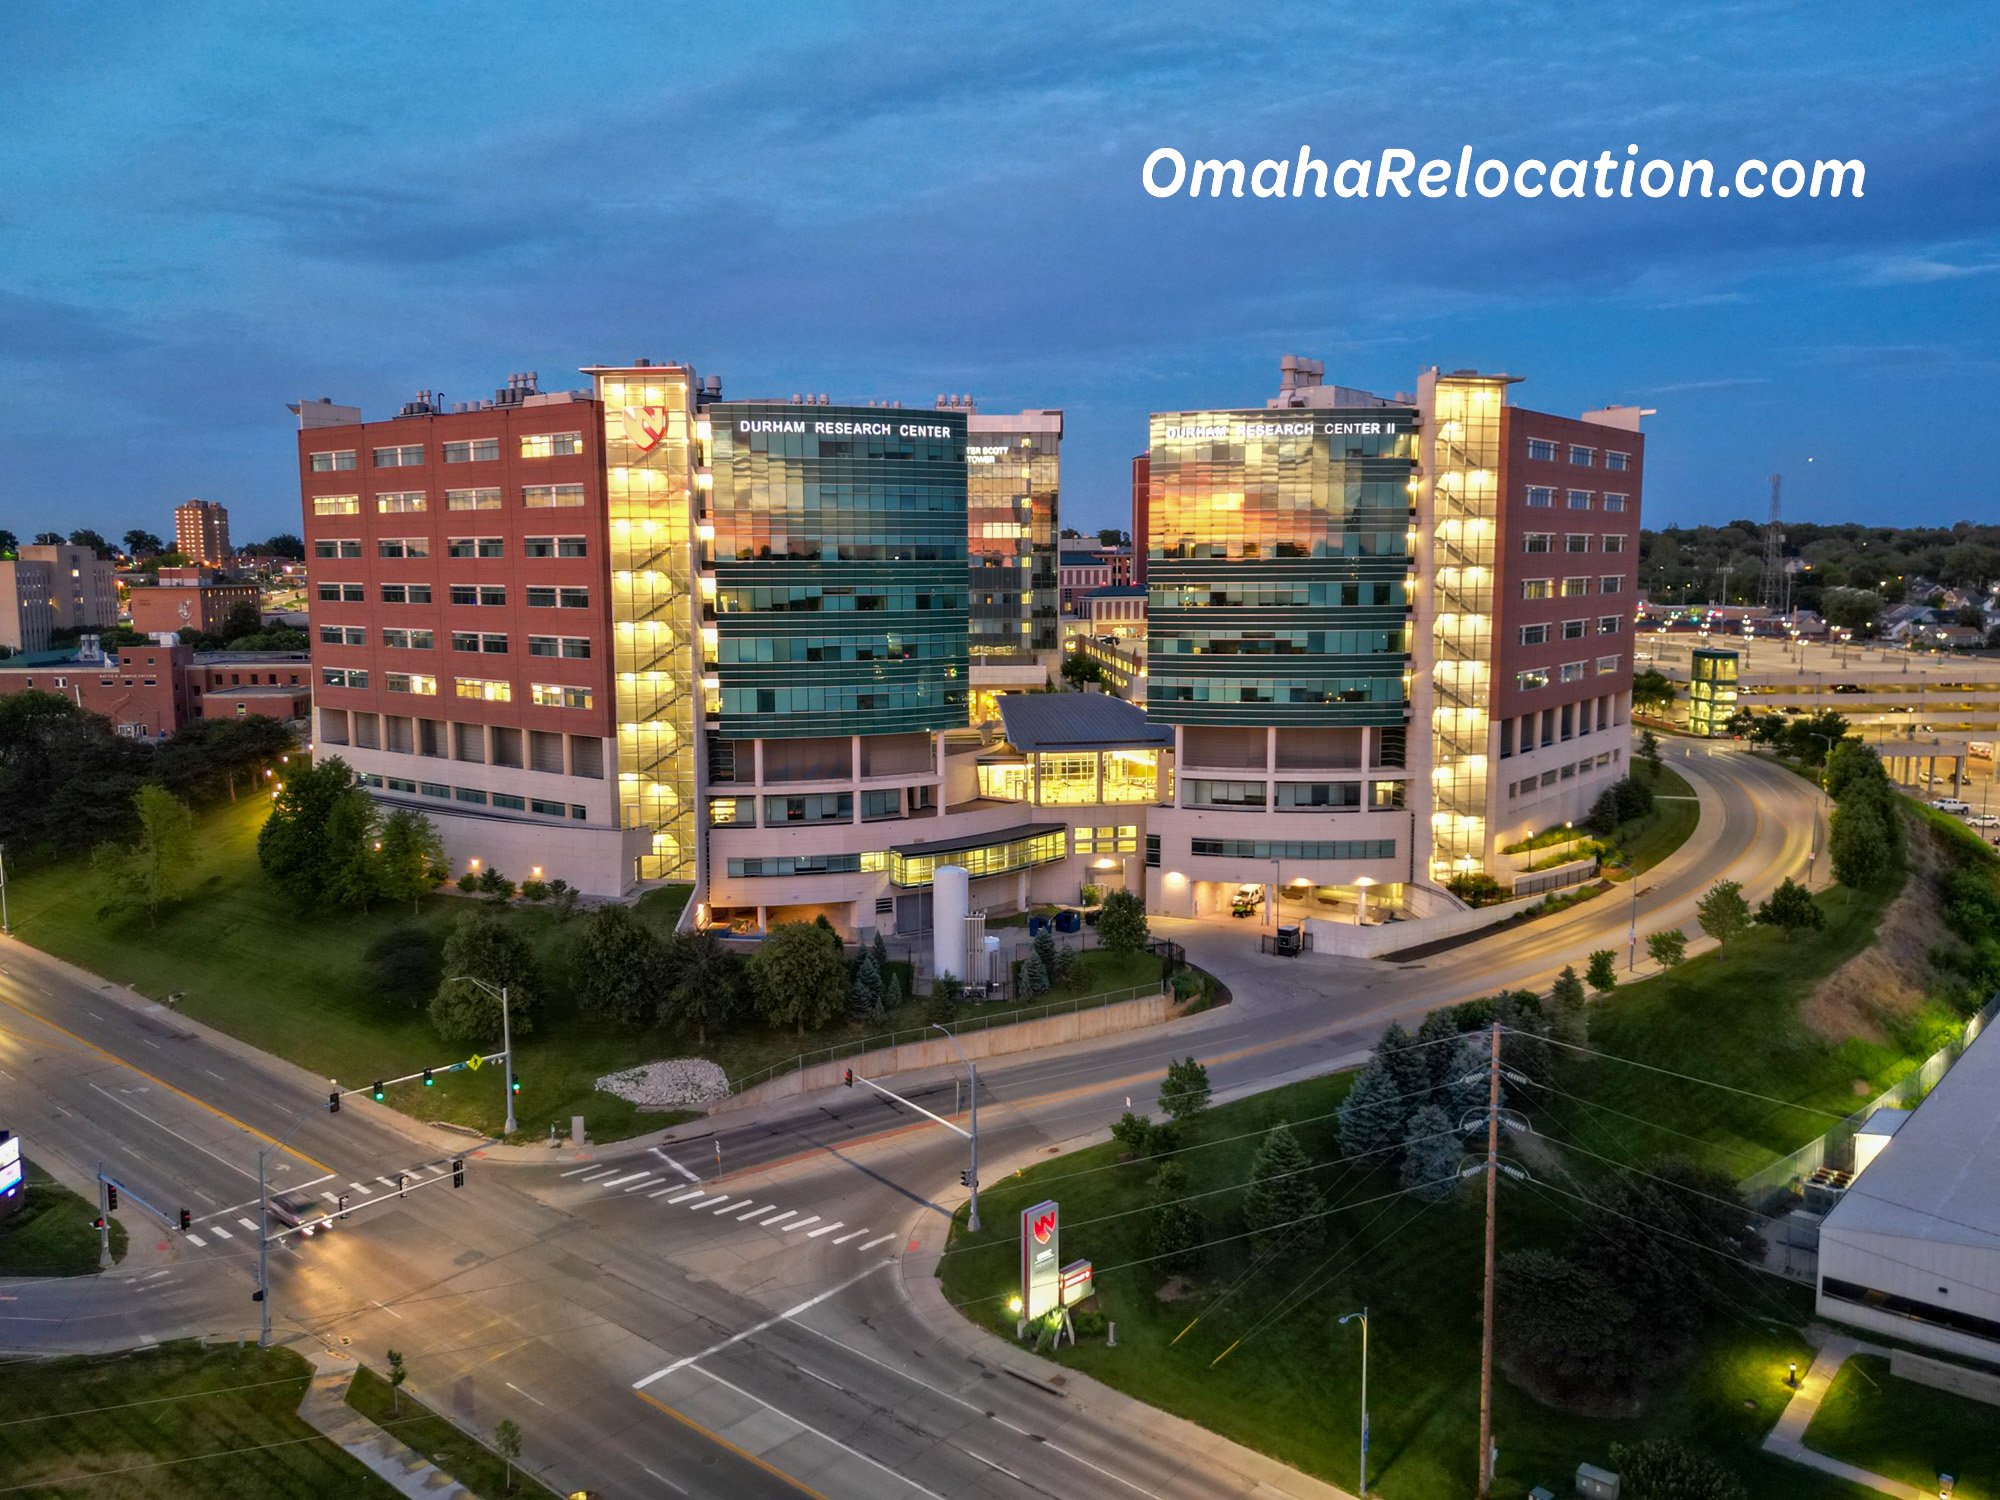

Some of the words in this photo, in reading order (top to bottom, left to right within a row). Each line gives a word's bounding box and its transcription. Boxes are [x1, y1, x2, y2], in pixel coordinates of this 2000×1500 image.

[740, 420, 805, 433] DURHAM
[815, 421, 891, 436] RESEARCH
[900, 424, 951, 438] CENTER
[1166, 425, 1227, 440] DURHAM
[1236, 422, 1314, 437] RESEARCH
[1324, 422, 1381, 435] CENTER
[1386, 422, 1396, 435] II
[982, 446, 1009, 456] SCOTT
[966, 455, 995, 465] TOWER
